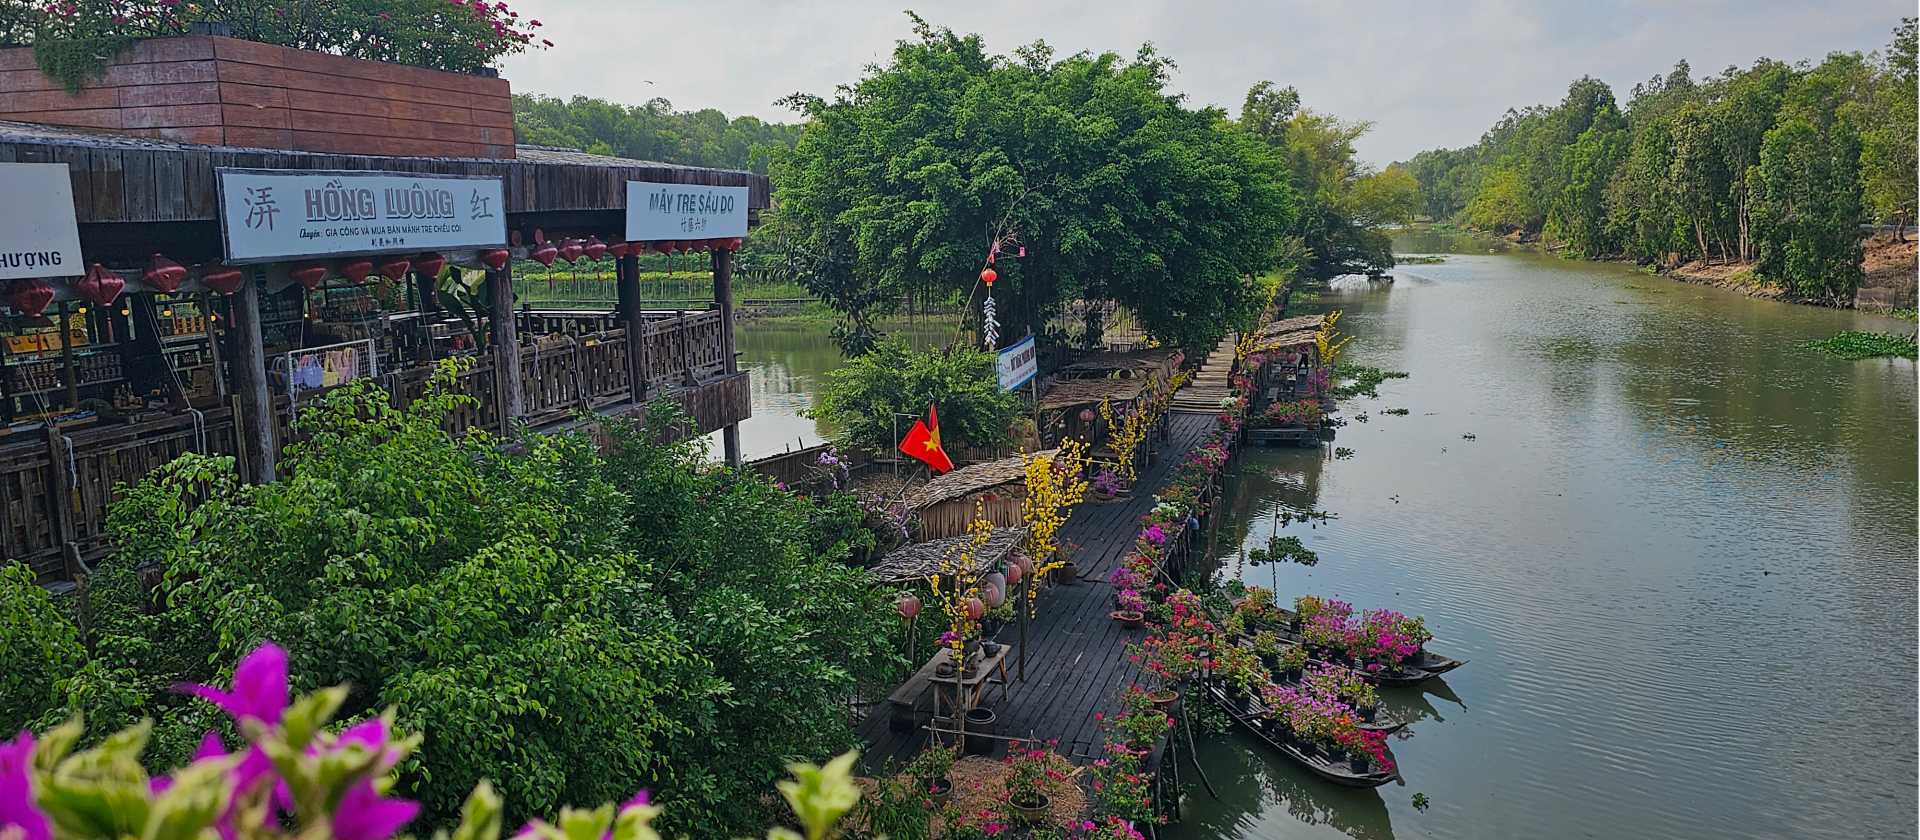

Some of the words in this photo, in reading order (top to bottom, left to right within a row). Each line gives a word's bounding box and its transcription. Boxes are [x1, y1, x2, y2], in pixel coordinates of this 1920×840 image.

[304, 177, 376, 223] HỒNG
[677, 193, 696, 214] TRE
[325, 228, 338, 237] GIA
[340, 225, 360, 237] CÔNG
[371, 226, 386, 235] MUA
[421, 225, 433, 233] TRE
